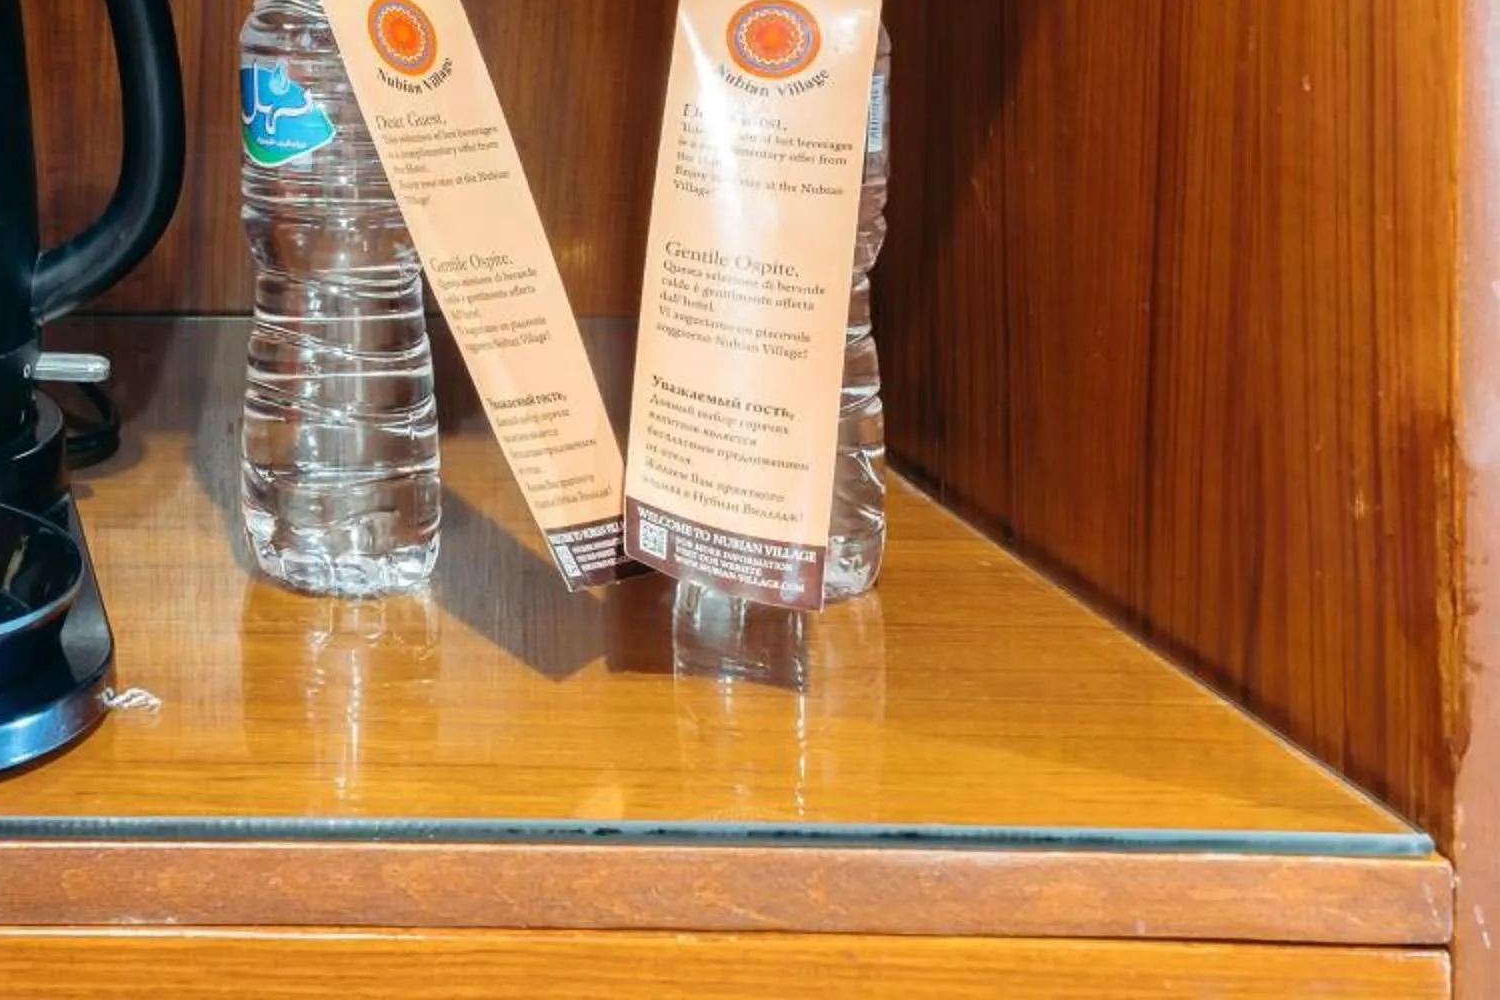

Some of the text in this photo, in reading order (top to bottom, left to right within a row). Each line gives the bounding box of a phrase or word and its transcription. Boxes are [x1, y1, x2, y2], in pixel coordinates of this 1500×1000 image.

[376, 67, 423, 95] Nubian
[776, 67, 830, 98] Village
[664, 240, 729, 267] Gentile
[652, 375, 741, 411] Уважаемый
[637, 506, 694, 536] WELCOME
[694, 526, 712, 542] TO
[713, 532, 763, 554] NUBIAN
[763, 542, 817, 564] VILLAGE
